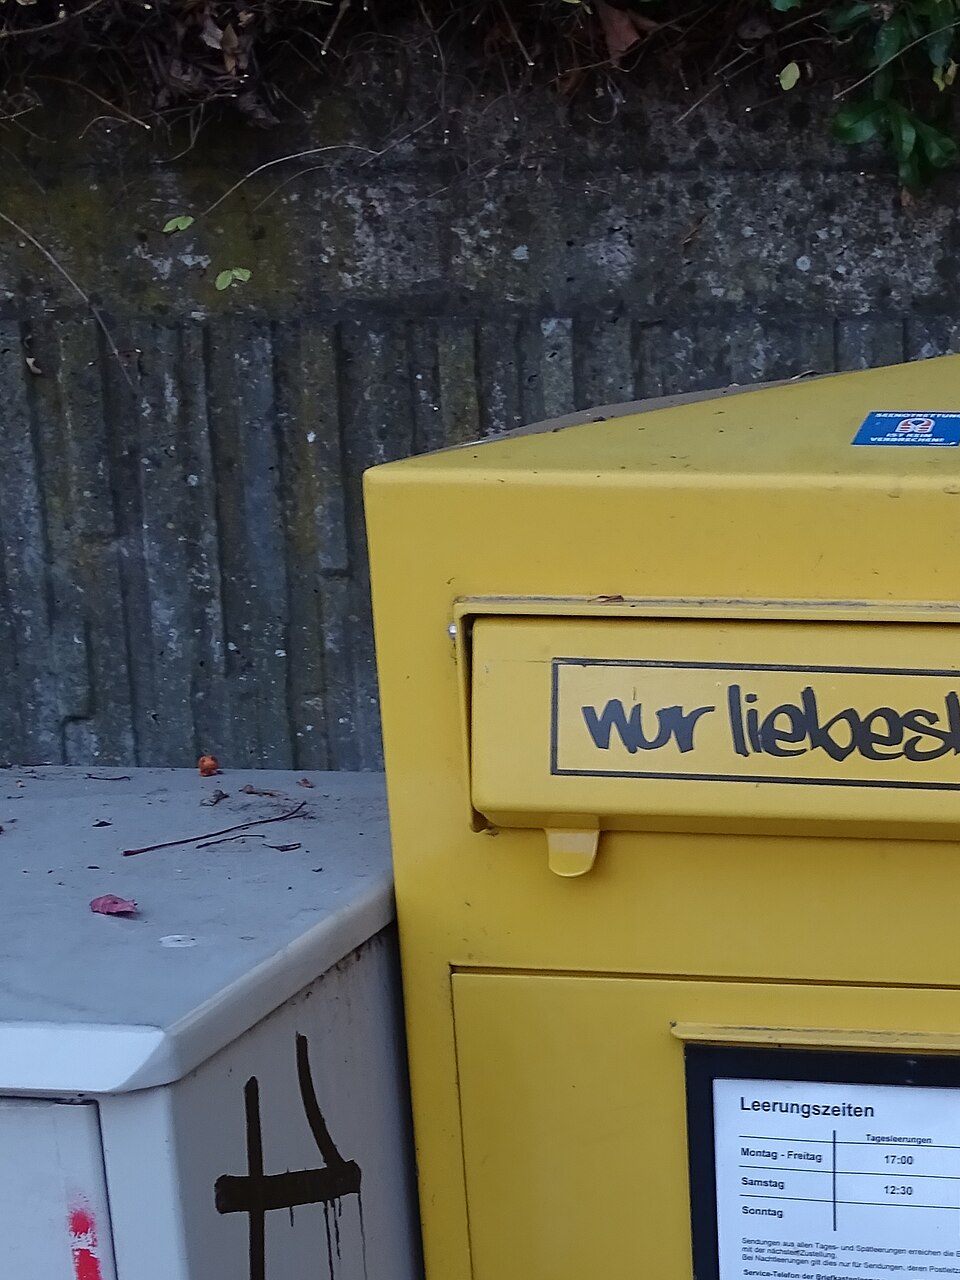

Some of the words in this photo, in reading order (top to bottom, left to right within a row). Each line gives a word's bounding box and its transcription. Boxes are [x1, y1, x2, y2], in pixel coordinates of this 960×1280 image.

[581, 697, 714, 753] nur
[740, 1097, 875, 1118] Leerungszeiten
[866, 1134, 932, 1144] Tagesleerungen
[740, 1148, 778, 1160] Montag
[787, 1151, 822, 1163] Freitag
[884, 1155, 914, 1165] 17:00
[741, 1177, 784, 1190] Samstag
[884, 1186, 913, 1195] 12:30
[742, 1206, 783, 1218] Sonntag
[742, 1238, 780, 1247] Sendungen
[815, 1242, 839, 1250] Tages-
[856, 1245, 906, 1255] Spätleerungen
[800, 1249, 837, 1259] Zustellung.
[755, 1255, 809, 1265] Nachtleerungen
[743, 1269, 800, 1279] Service-Telefon
